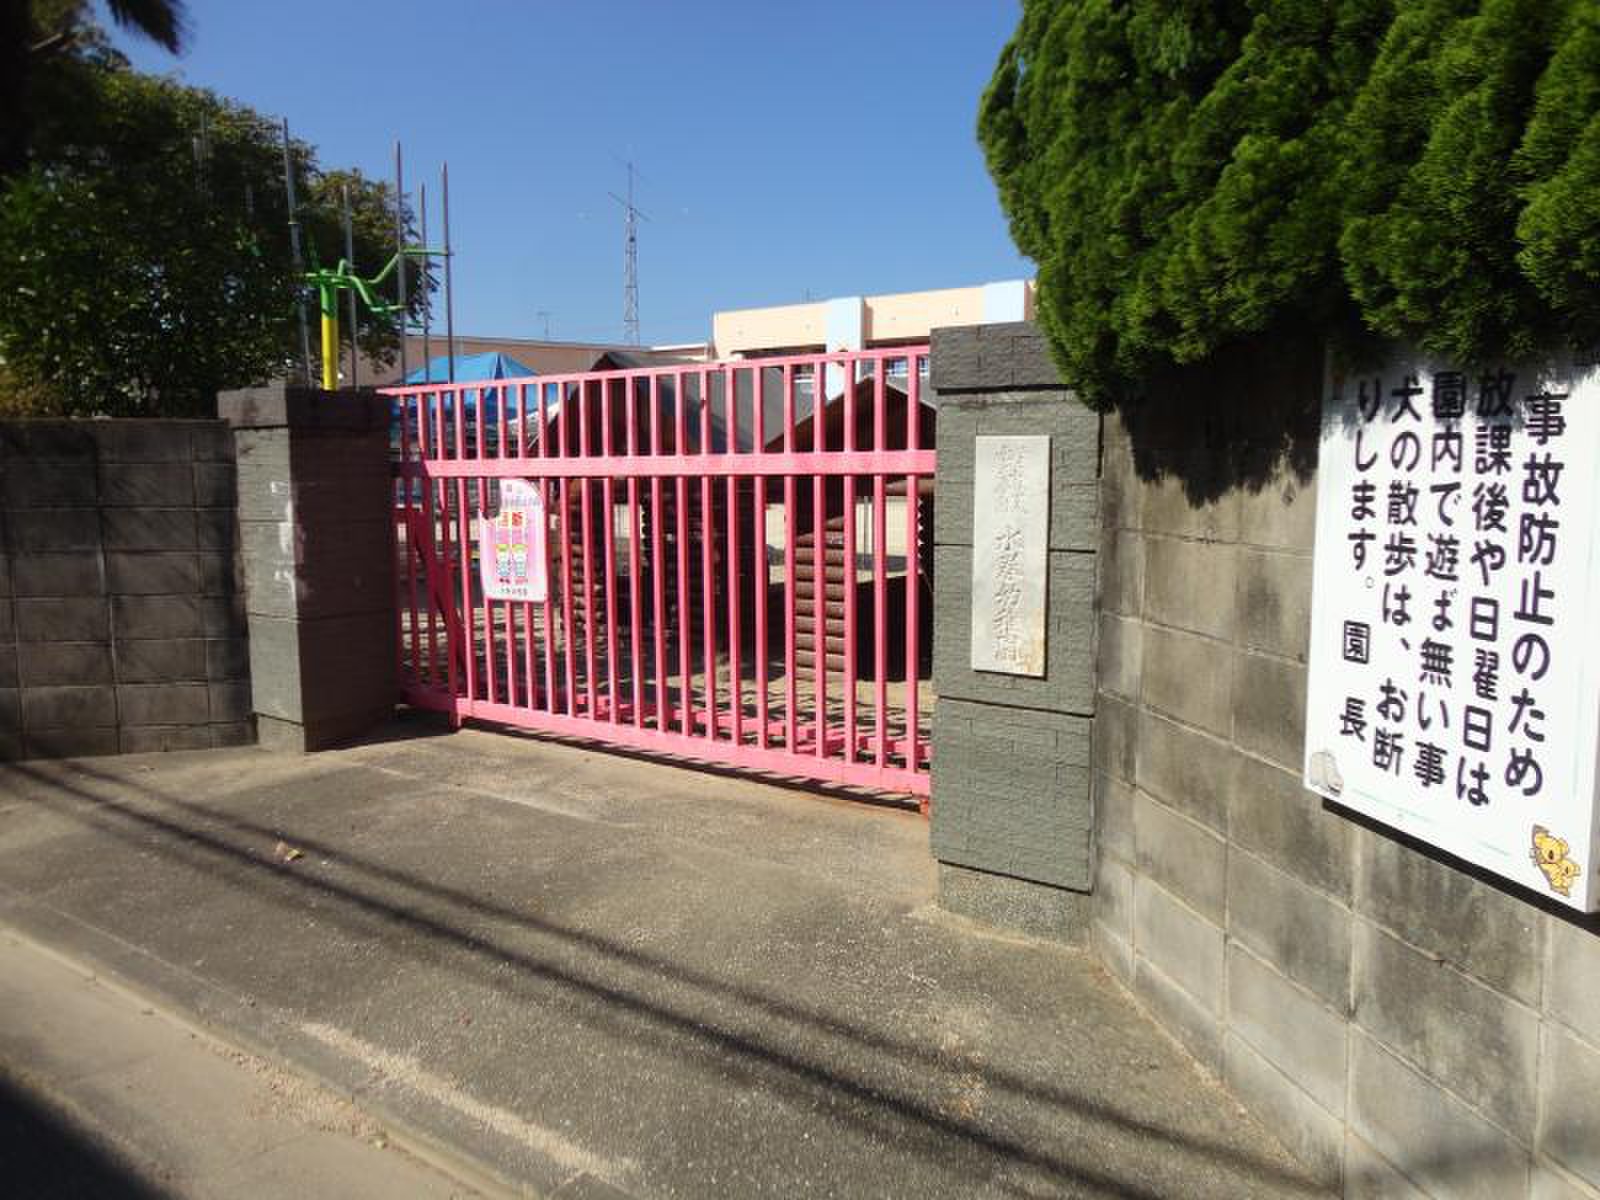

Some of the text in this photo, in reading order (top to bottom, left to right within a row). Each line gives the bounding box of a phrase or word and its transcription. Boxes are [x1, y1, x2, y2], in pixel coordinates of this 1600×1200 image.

[1413, 371, 1467, 787] 園内で遊ば無い事
[1456, 368, 1517, 806] 放課後や日曜日は
[1505, 389, 1569, 797] 事故防止のため
